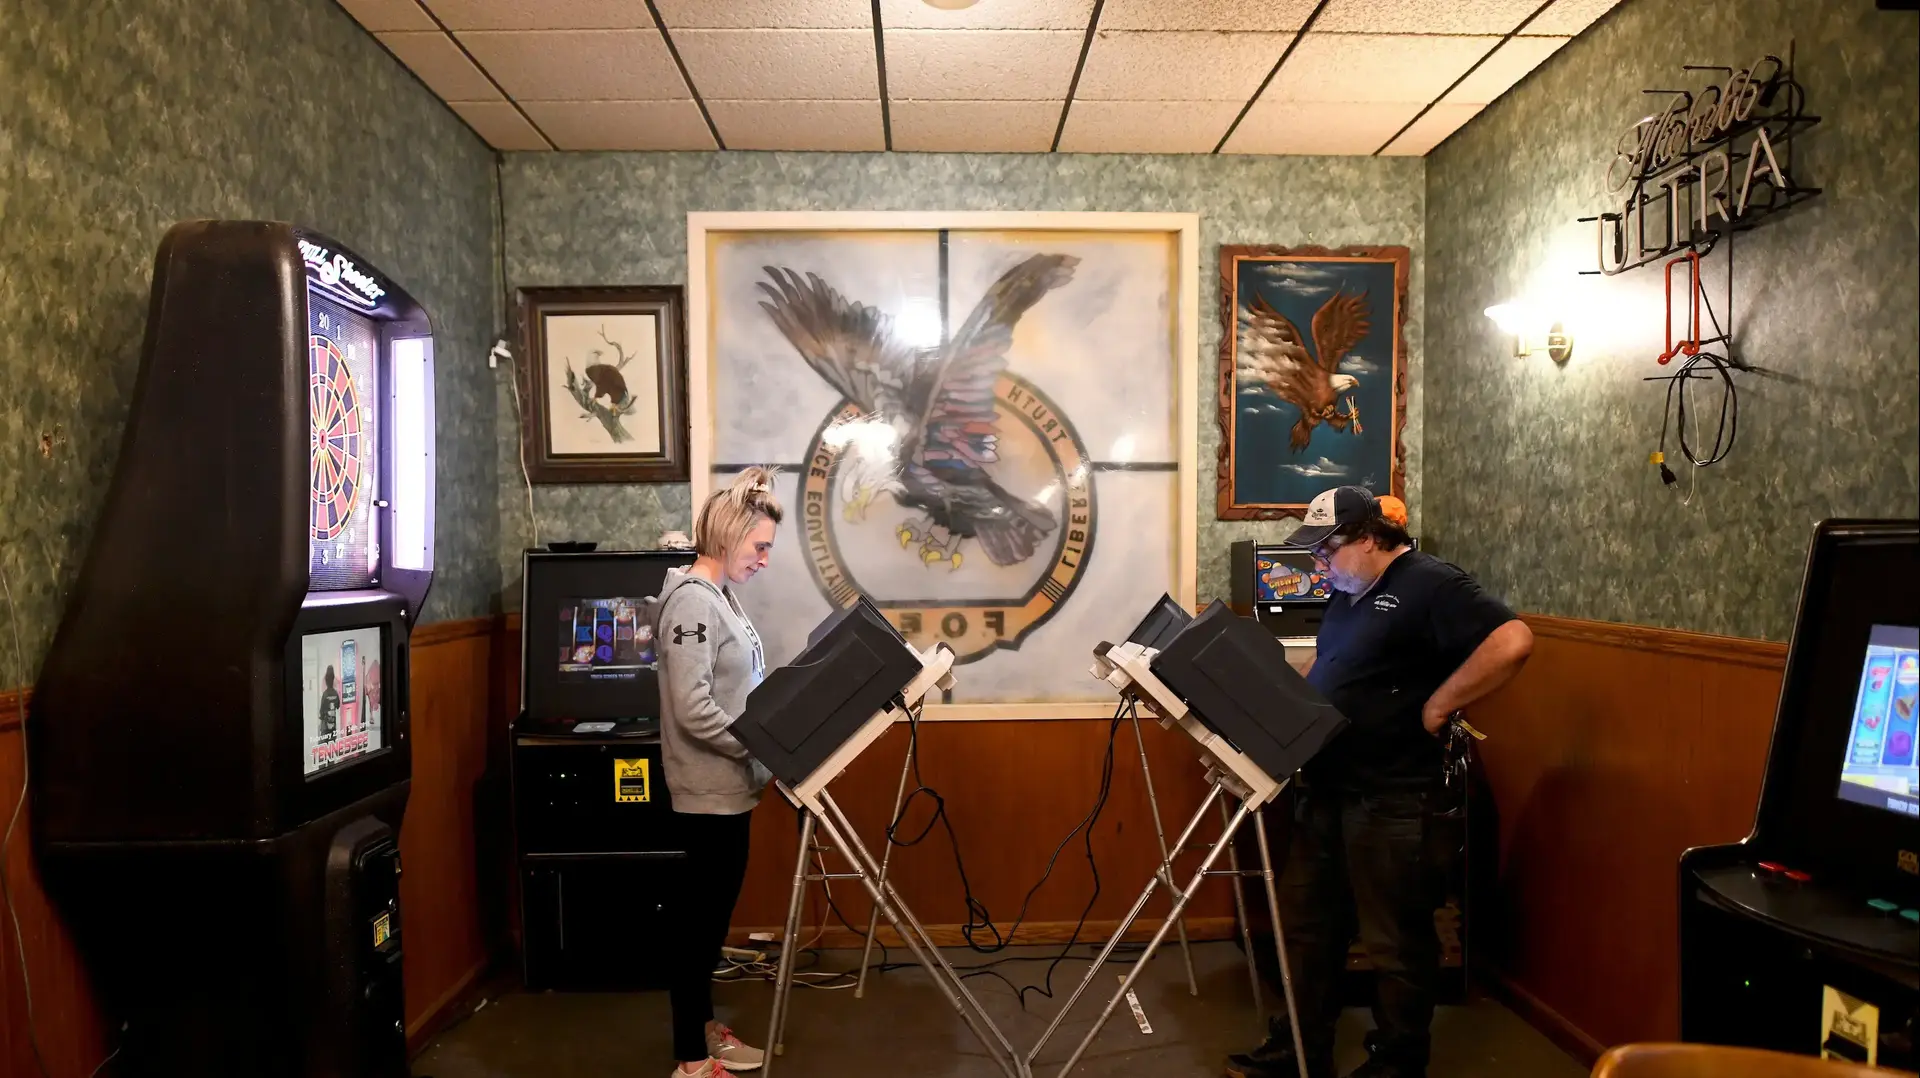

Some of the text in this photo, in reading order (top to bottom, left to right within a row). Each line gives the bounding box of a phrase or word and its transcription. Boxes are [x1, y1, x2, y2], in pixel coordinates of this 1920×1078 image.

[1598, 127, 1786, 276] ULTRA
[318, 312, 330, 330] 20
[321, 548, 329, 566] 3
[311, 732, 369, 765] TENNESSEE
